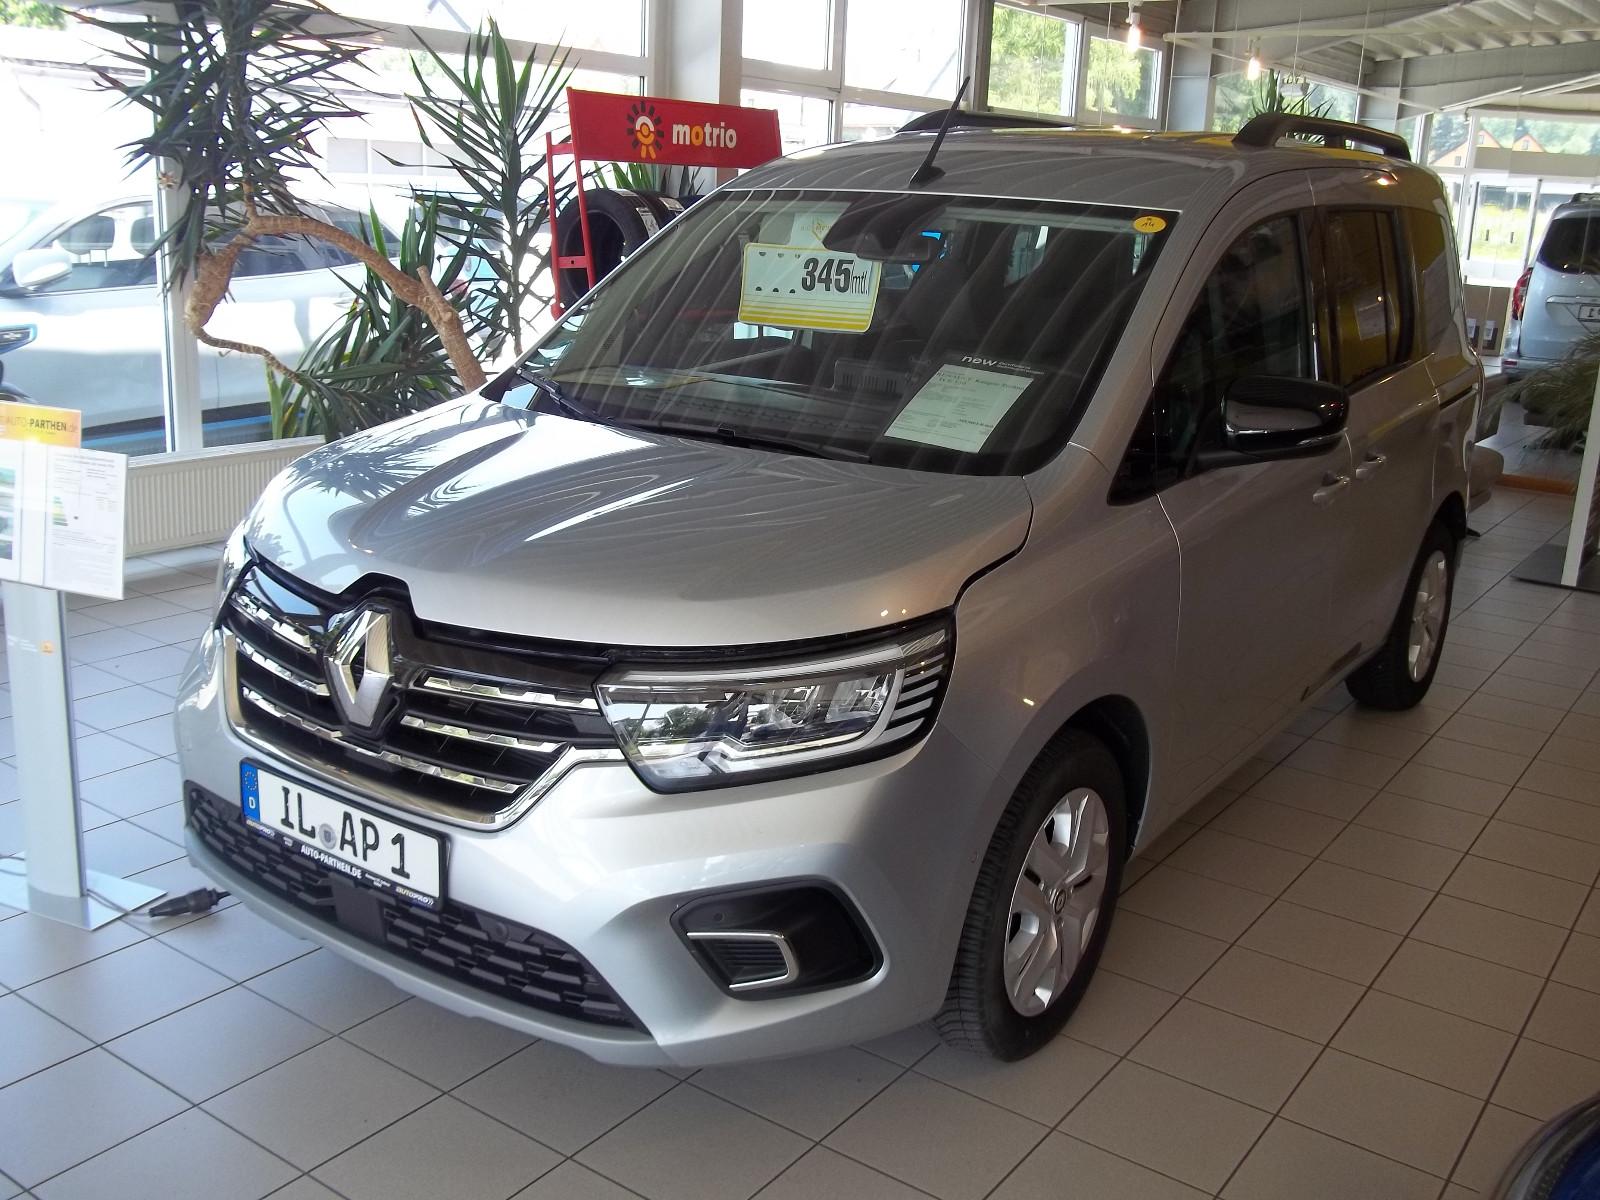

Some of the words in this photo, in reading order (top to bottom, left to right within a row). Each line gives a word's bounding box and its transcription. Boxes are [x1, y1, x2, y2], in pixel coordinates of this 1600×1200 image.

[672, 121, 737, 149] motrio
[801, 257, 854, 294] 345
[248, 796, 257, 810] D
[279, 785, 316, 839] IL
[339, 810, 380, 862] AP
[390, 832, 411, 880] 1
